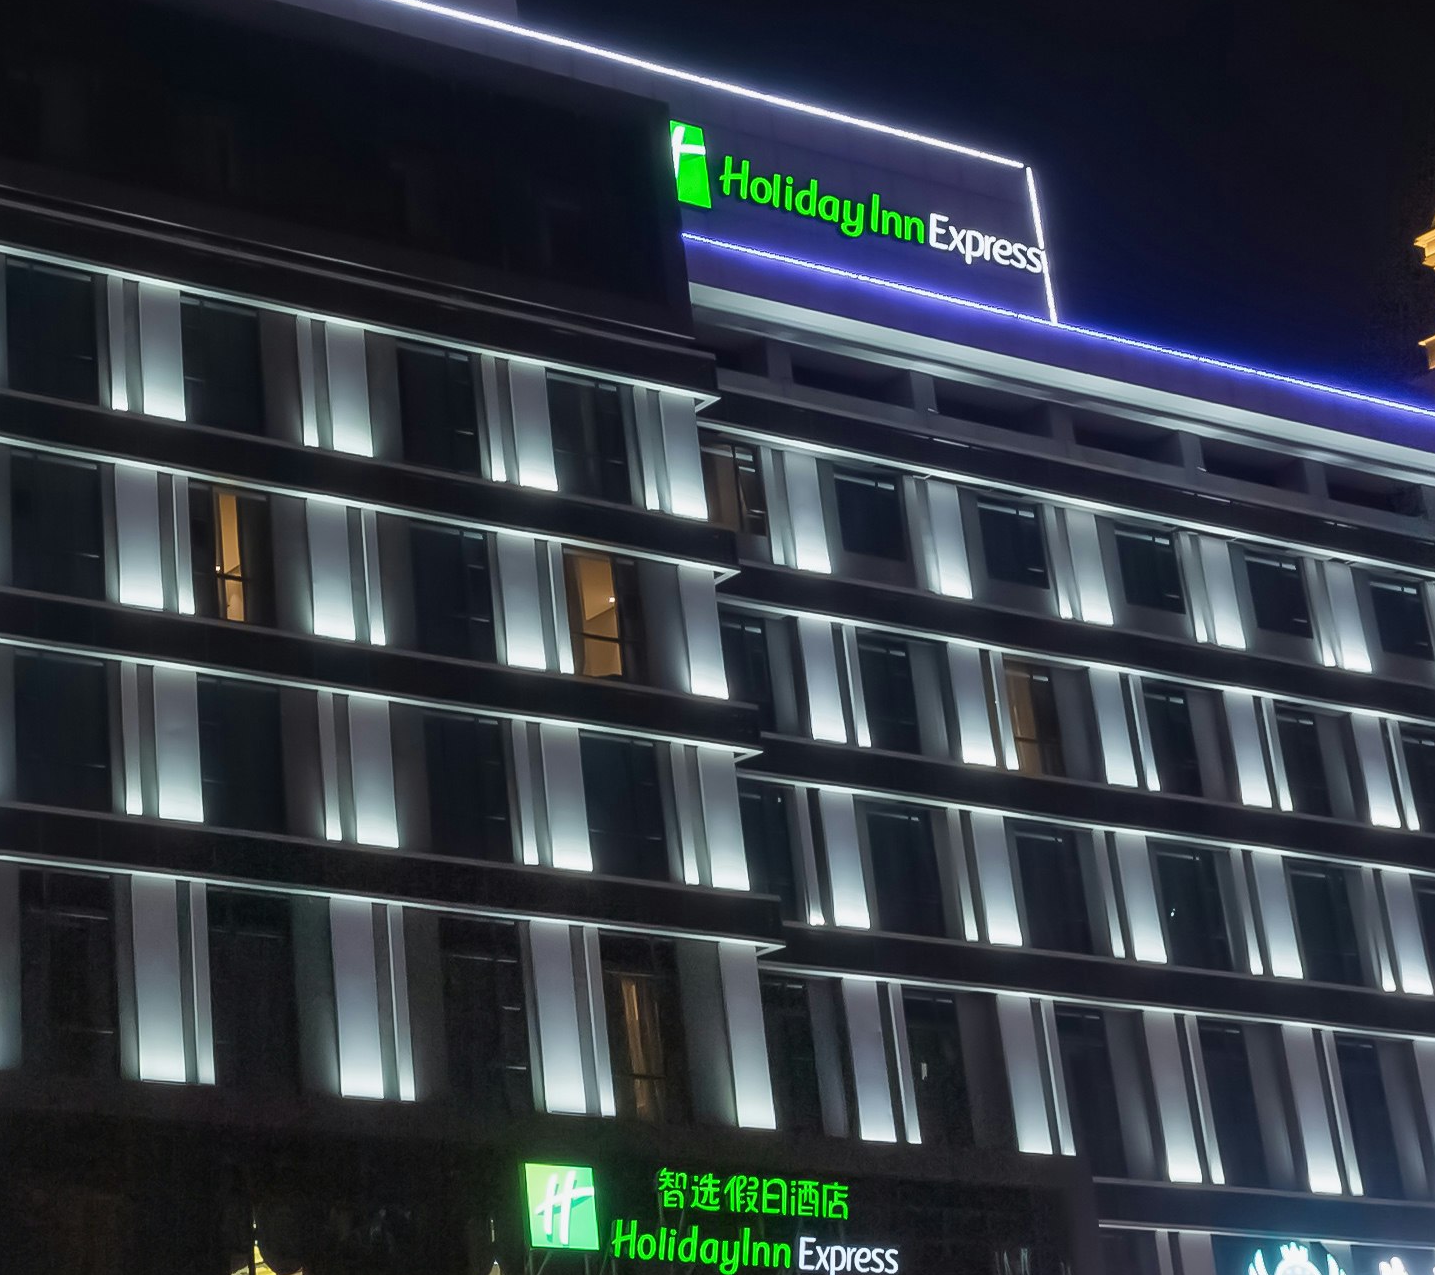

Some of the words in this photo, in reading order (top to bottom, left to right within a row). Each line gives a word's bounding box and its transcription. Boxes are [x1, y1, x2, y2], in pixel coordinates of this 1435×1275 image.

[718, 155, 865, 238] Holiday
[928, 212, 1047, 276] Express
[657, 1167, 849, 1221] 智选假日酒店
[611, 1219, 741, 1275] Holiday
